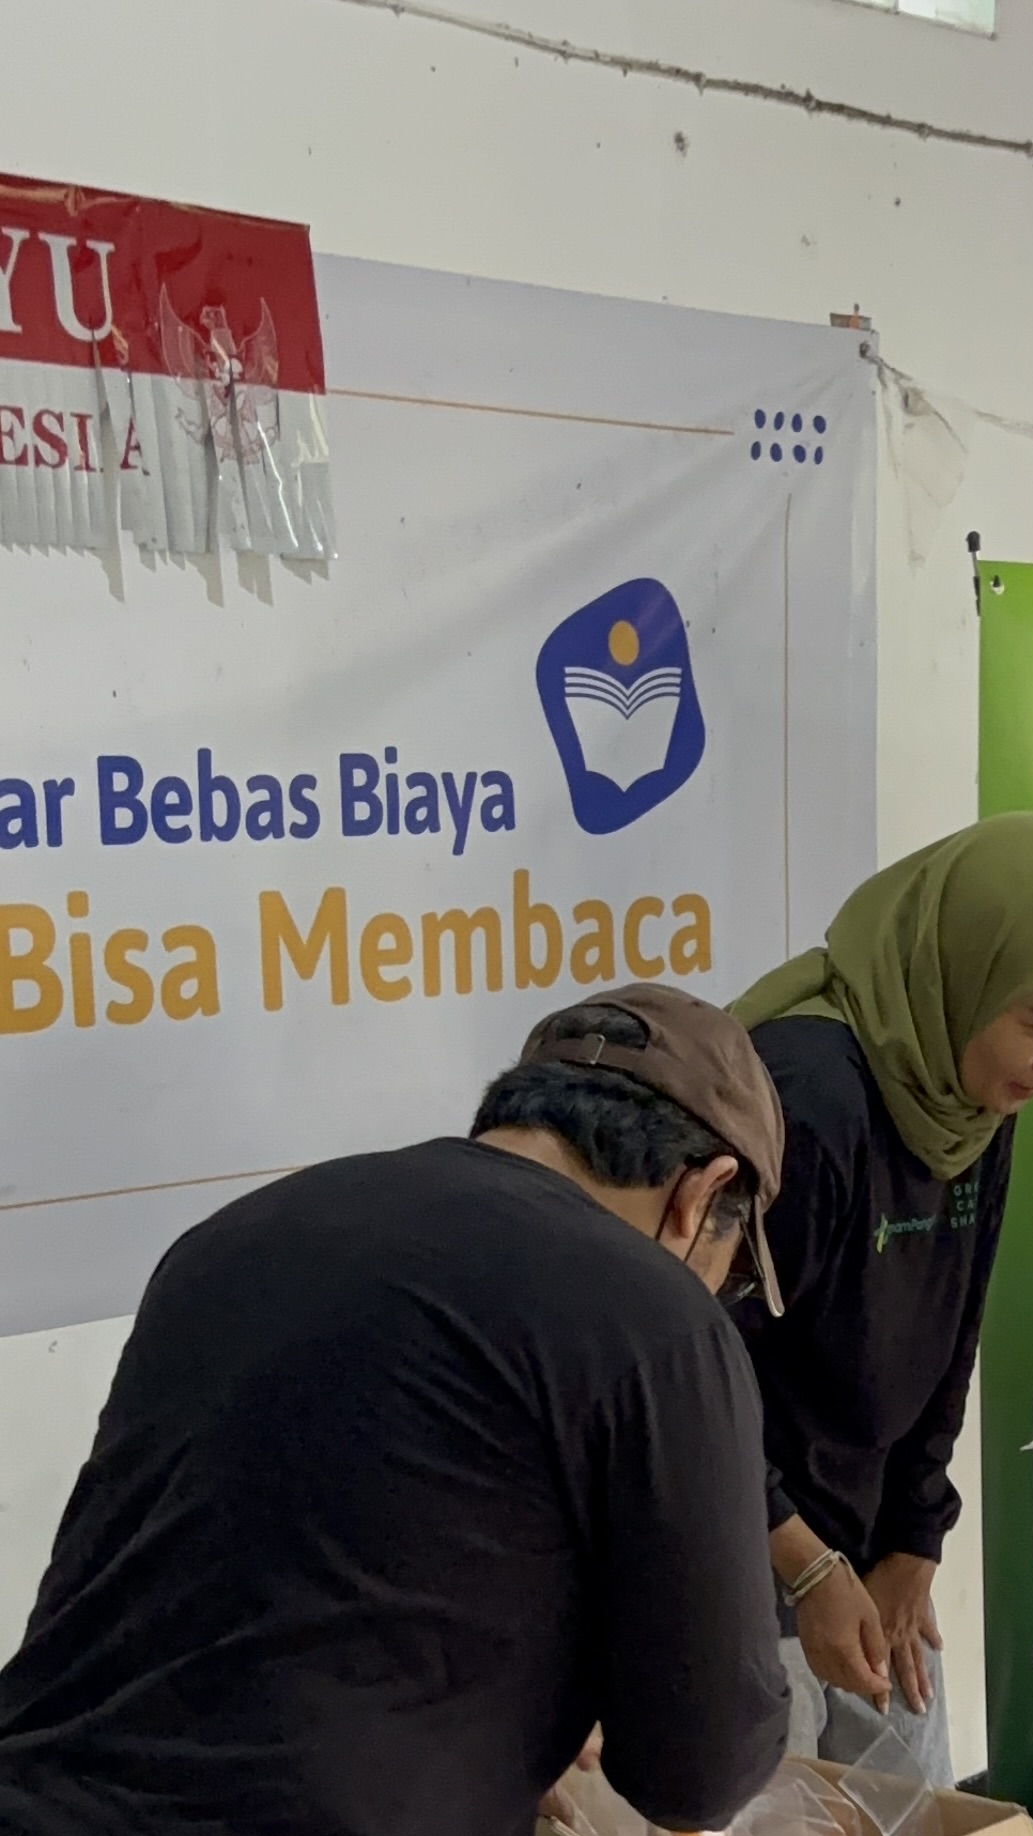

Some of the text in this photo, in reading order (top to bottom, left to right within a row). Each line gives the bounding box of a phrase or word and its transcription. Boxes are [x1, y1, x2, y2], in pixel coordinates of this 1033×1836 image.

[97, 748, 321, 846] Bebas
[339, 746, 517, 856] Biaya
[0, 869, 713, 1035] Bisa Membaca
